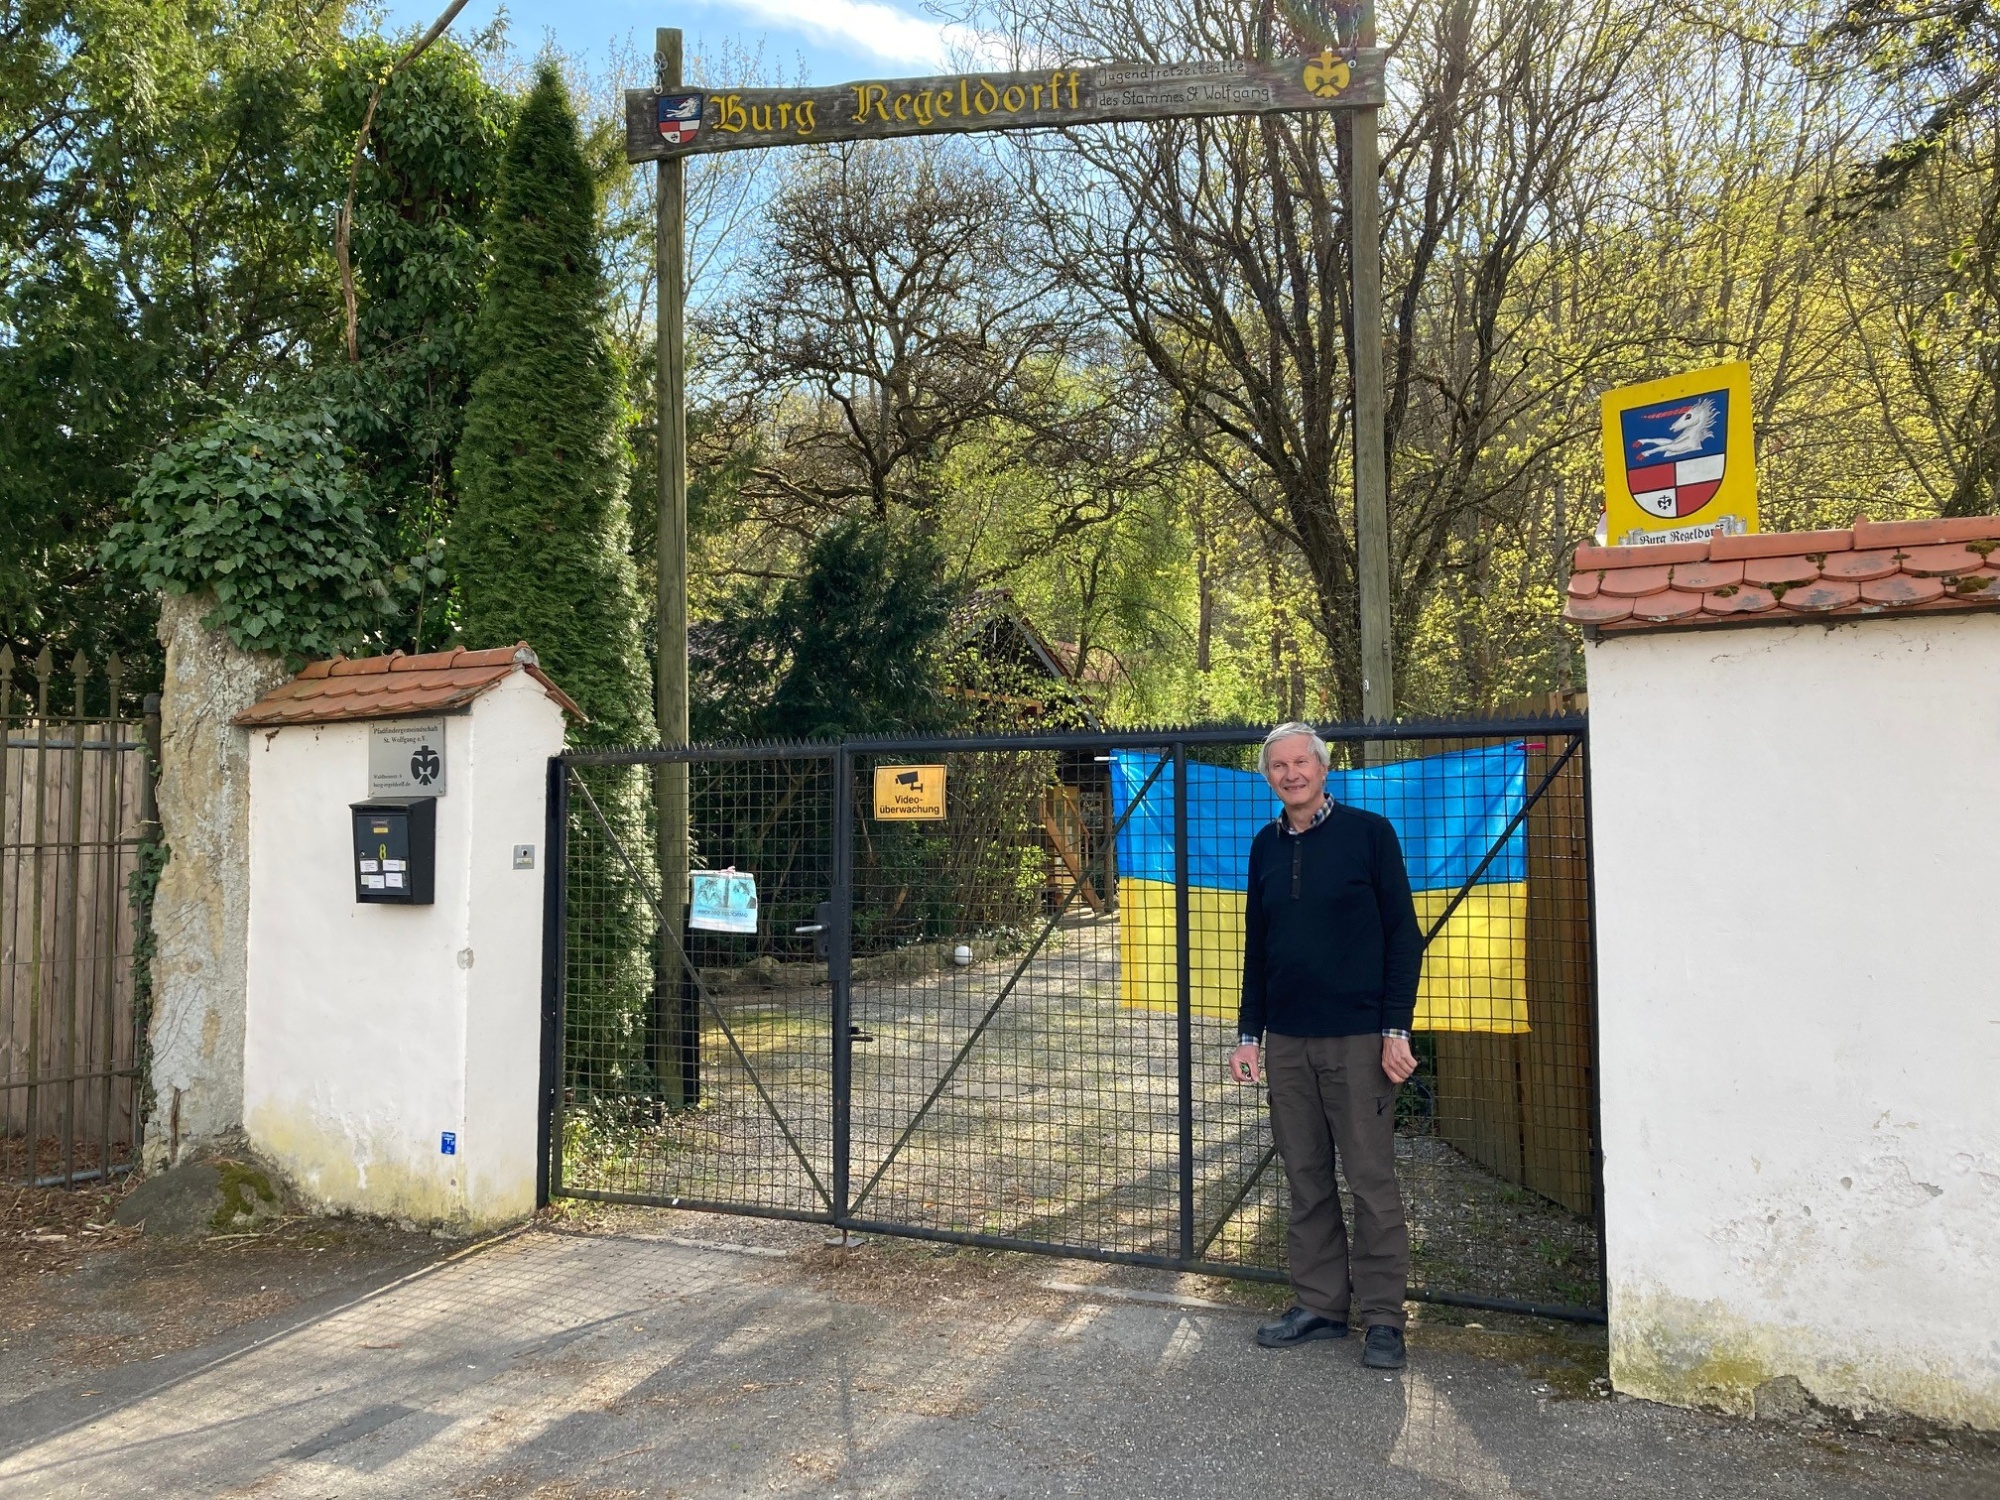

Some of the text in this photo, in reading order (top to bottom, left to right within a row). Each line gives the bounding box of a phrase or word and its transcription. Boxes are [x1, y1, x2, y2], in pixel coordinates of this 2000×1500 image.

[1099, 93, 1118, 106] des
[1121, 89, 1184, 105] Stammes
[1203, 84, 1270, 103] Wolfgang
[709, 70, 1080, 135] Burg Regeldorff
[391, 736, 416, 744] Wolfgang
[895, 795, 923, 804] Video-
[880, 805, 940, 815] überwachung
[379, 843, 387, 860] 8
